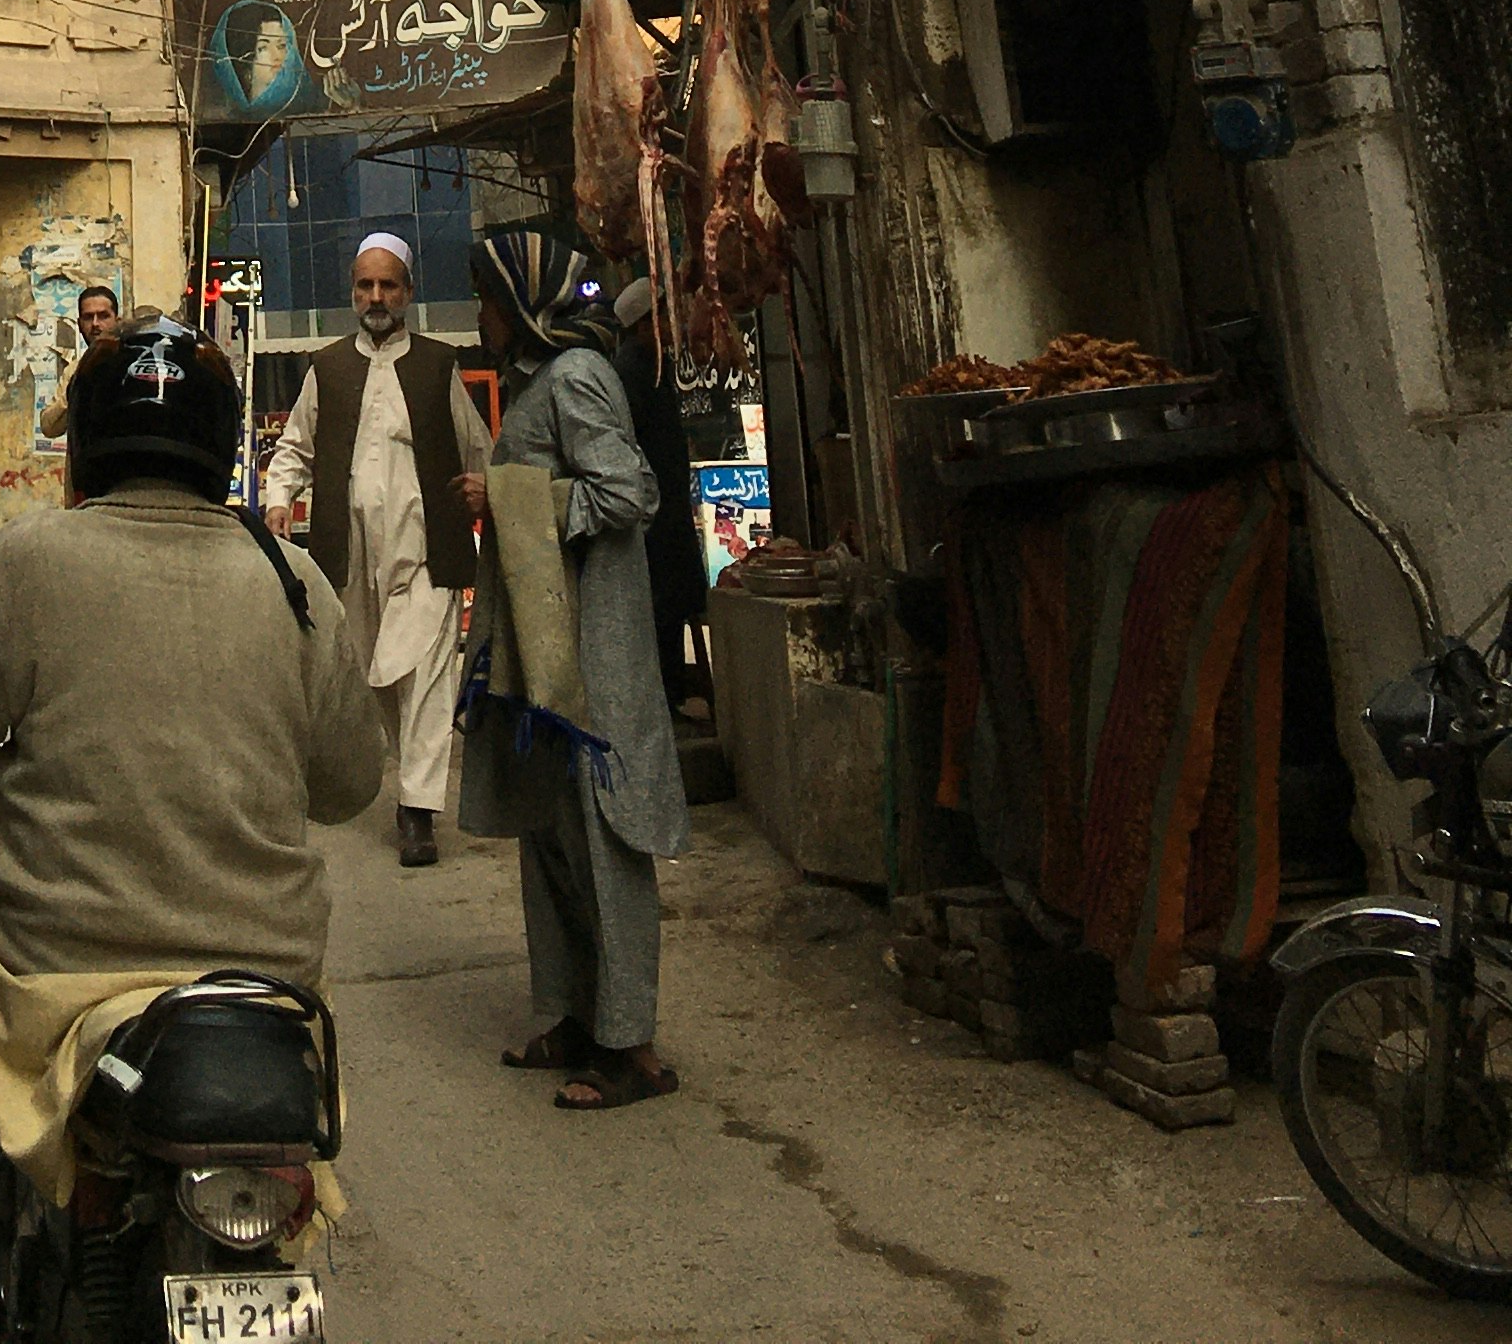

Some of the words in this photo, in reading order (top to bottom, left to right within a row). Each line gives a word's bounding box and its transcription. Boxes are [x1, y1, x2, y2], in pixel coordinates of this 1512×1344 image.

[133, 364, 180, 377] TEH
[221, 1282, 263, 1297] KPK
[178, 1305, 225, 1340] FH
[238, 1303, 315, 1338] 2111
